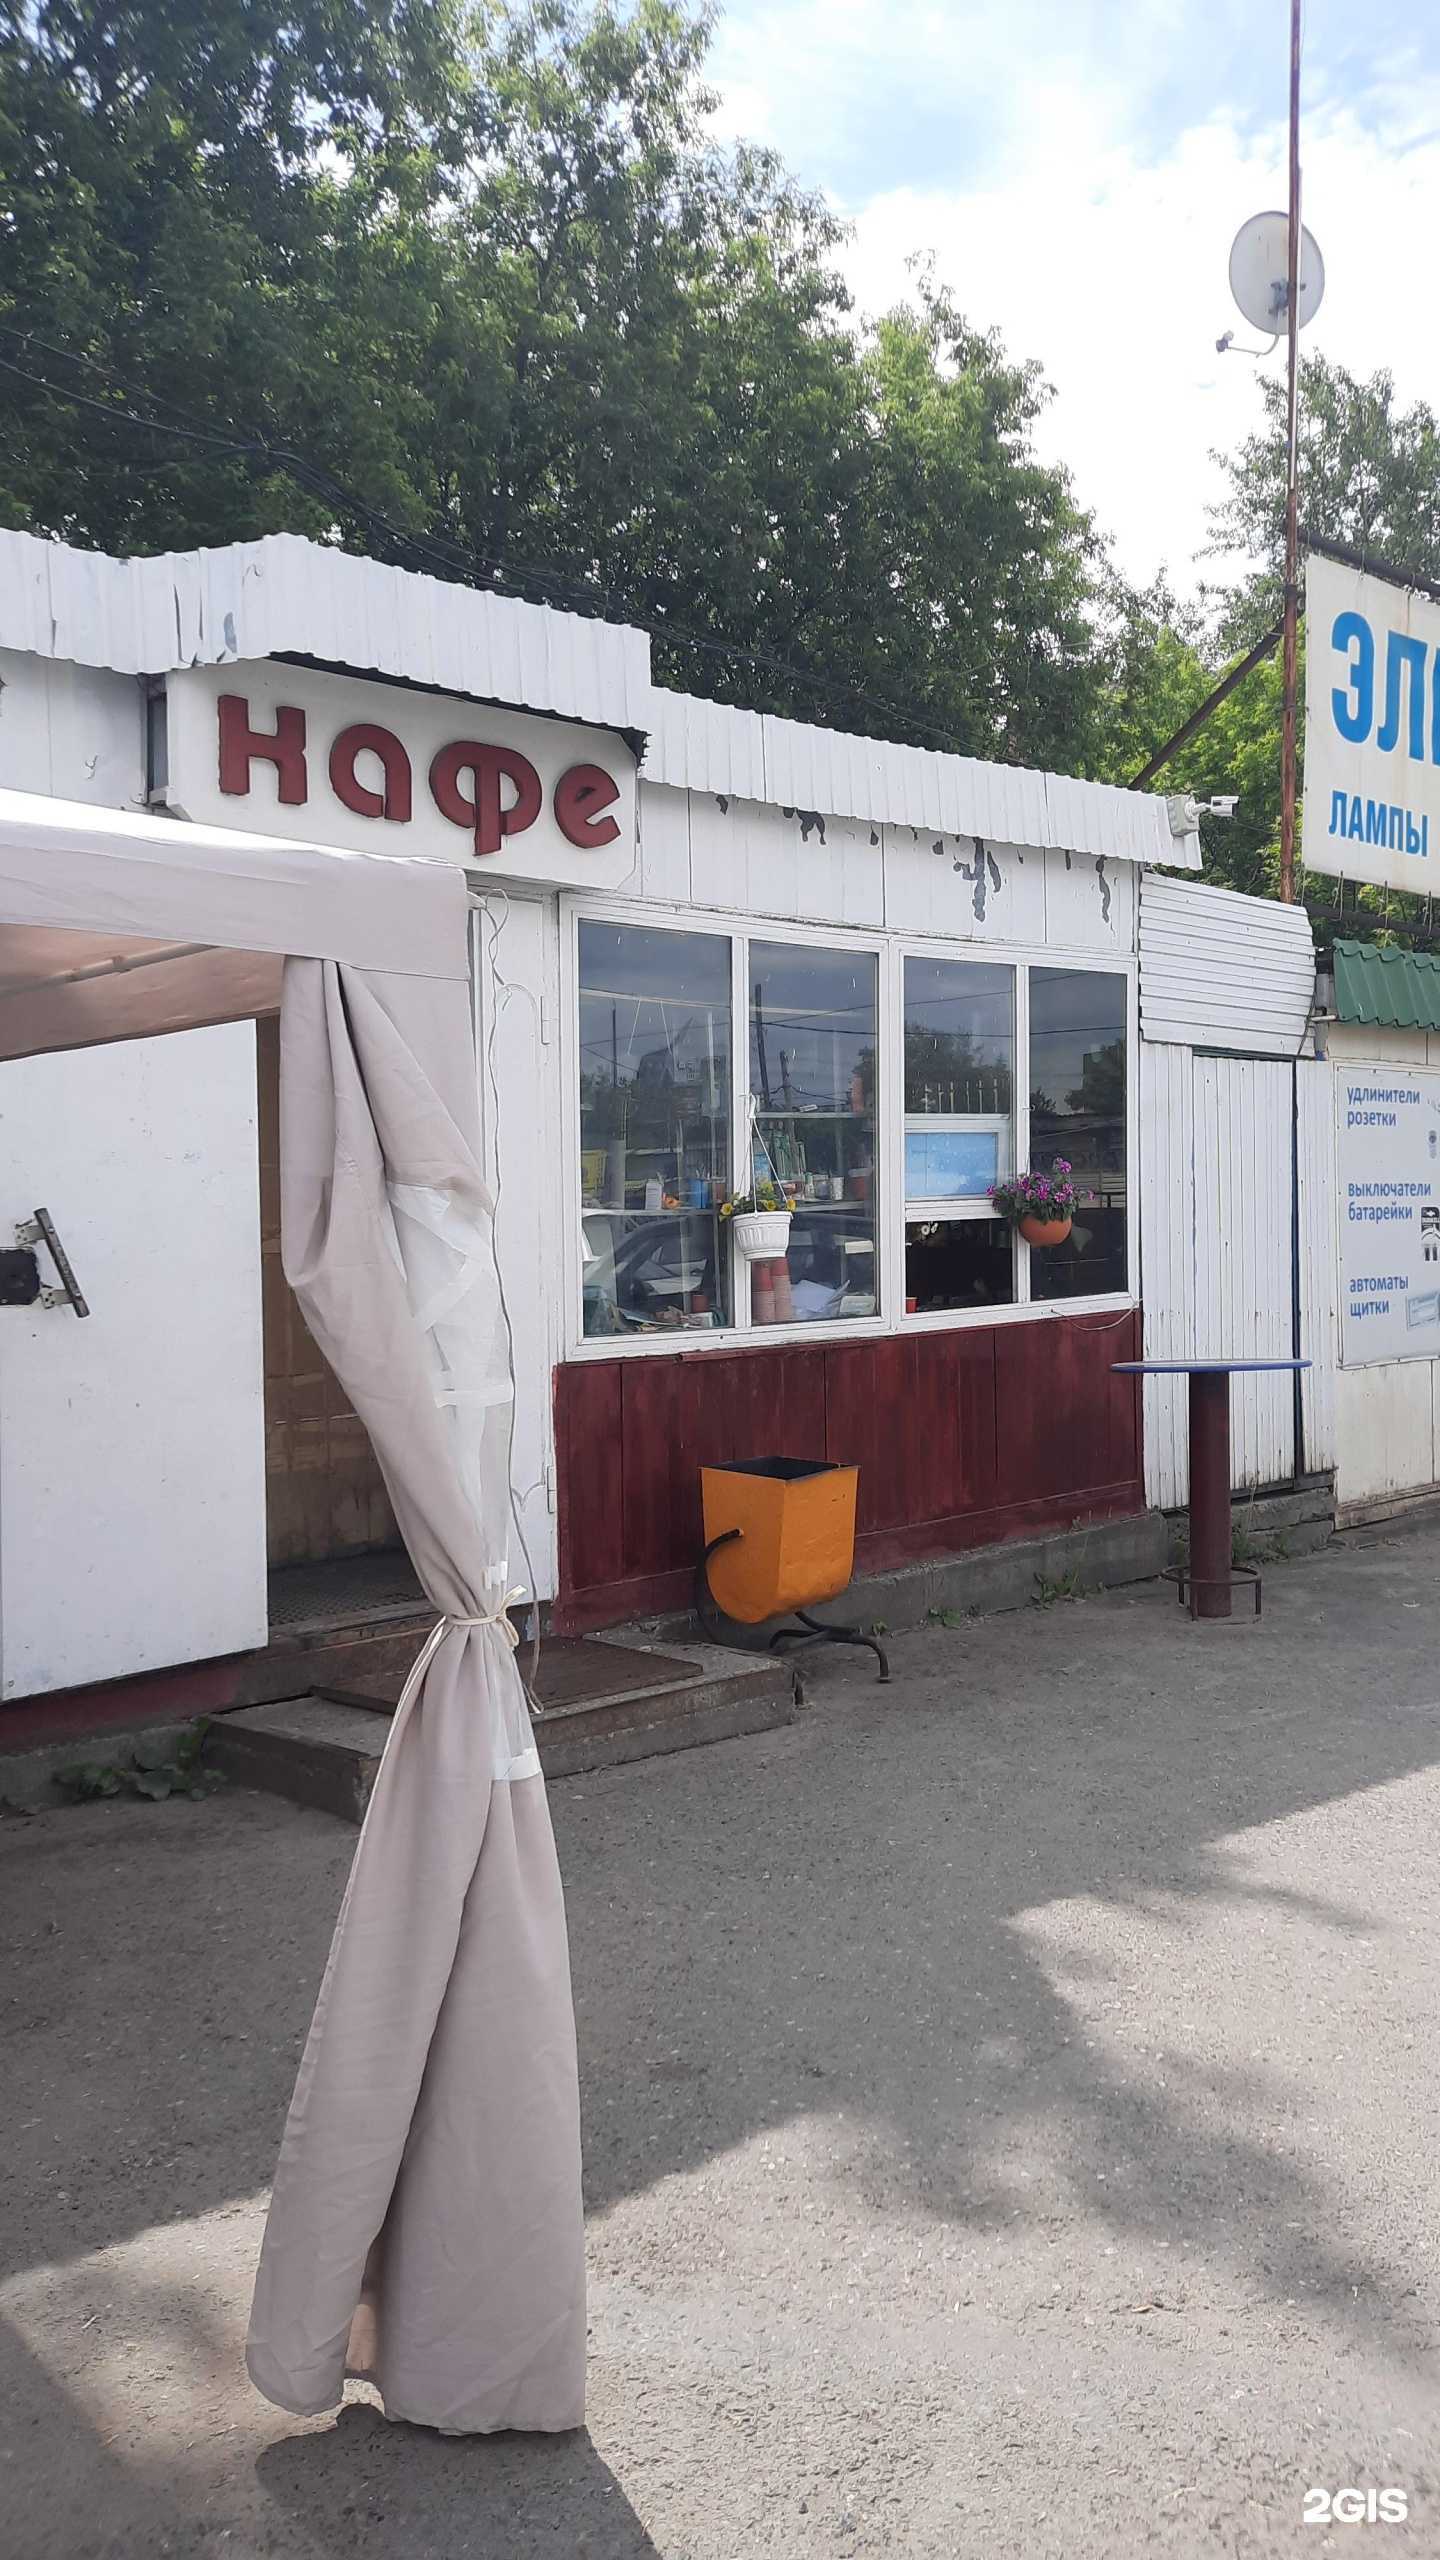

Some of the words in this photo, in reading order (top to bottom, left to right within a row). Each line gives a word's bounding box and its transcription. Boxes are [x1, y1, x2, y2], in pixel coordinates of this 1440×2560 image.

[1331, 611, 1440, 768] ЭЛ
[1329, 790, 1428, 857] ЛАМПЫ
[1347, 1086, 1420, 1104] удлинители
[1347, 1110, 1397, 1128] розетки
[1348, 1182, 1431, 1198] выключатели
[1348, 1201, 1413, 1223] батарейки
[1350, 1275, 1409, 1292] автоматы
[1350, 1299, 1390, 1318] щитки
